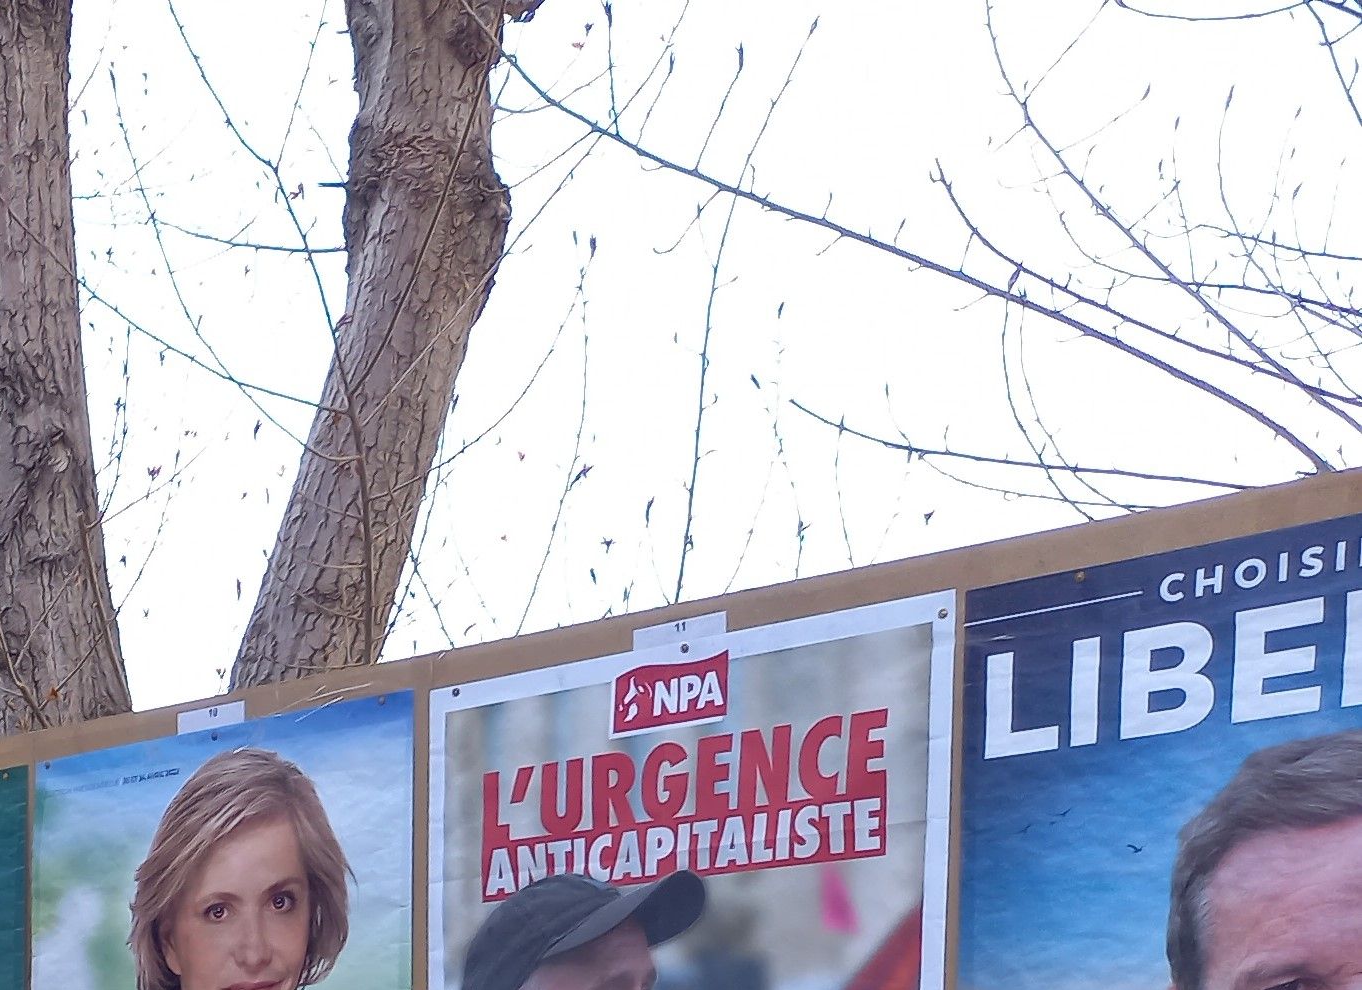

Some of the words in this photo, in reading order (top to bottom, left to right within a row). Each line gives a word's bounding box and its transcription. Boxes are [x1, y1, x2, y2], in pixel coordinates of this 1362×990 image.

[1159, 538, 1362, 602] CHOISI
[675, 622, 686, 632] 11
[653, 670, 724, 717] NPA
[482, 708, 889, 840] L'URGENCE
[484, 798, 882, 897] ANTICAPITALISTE
